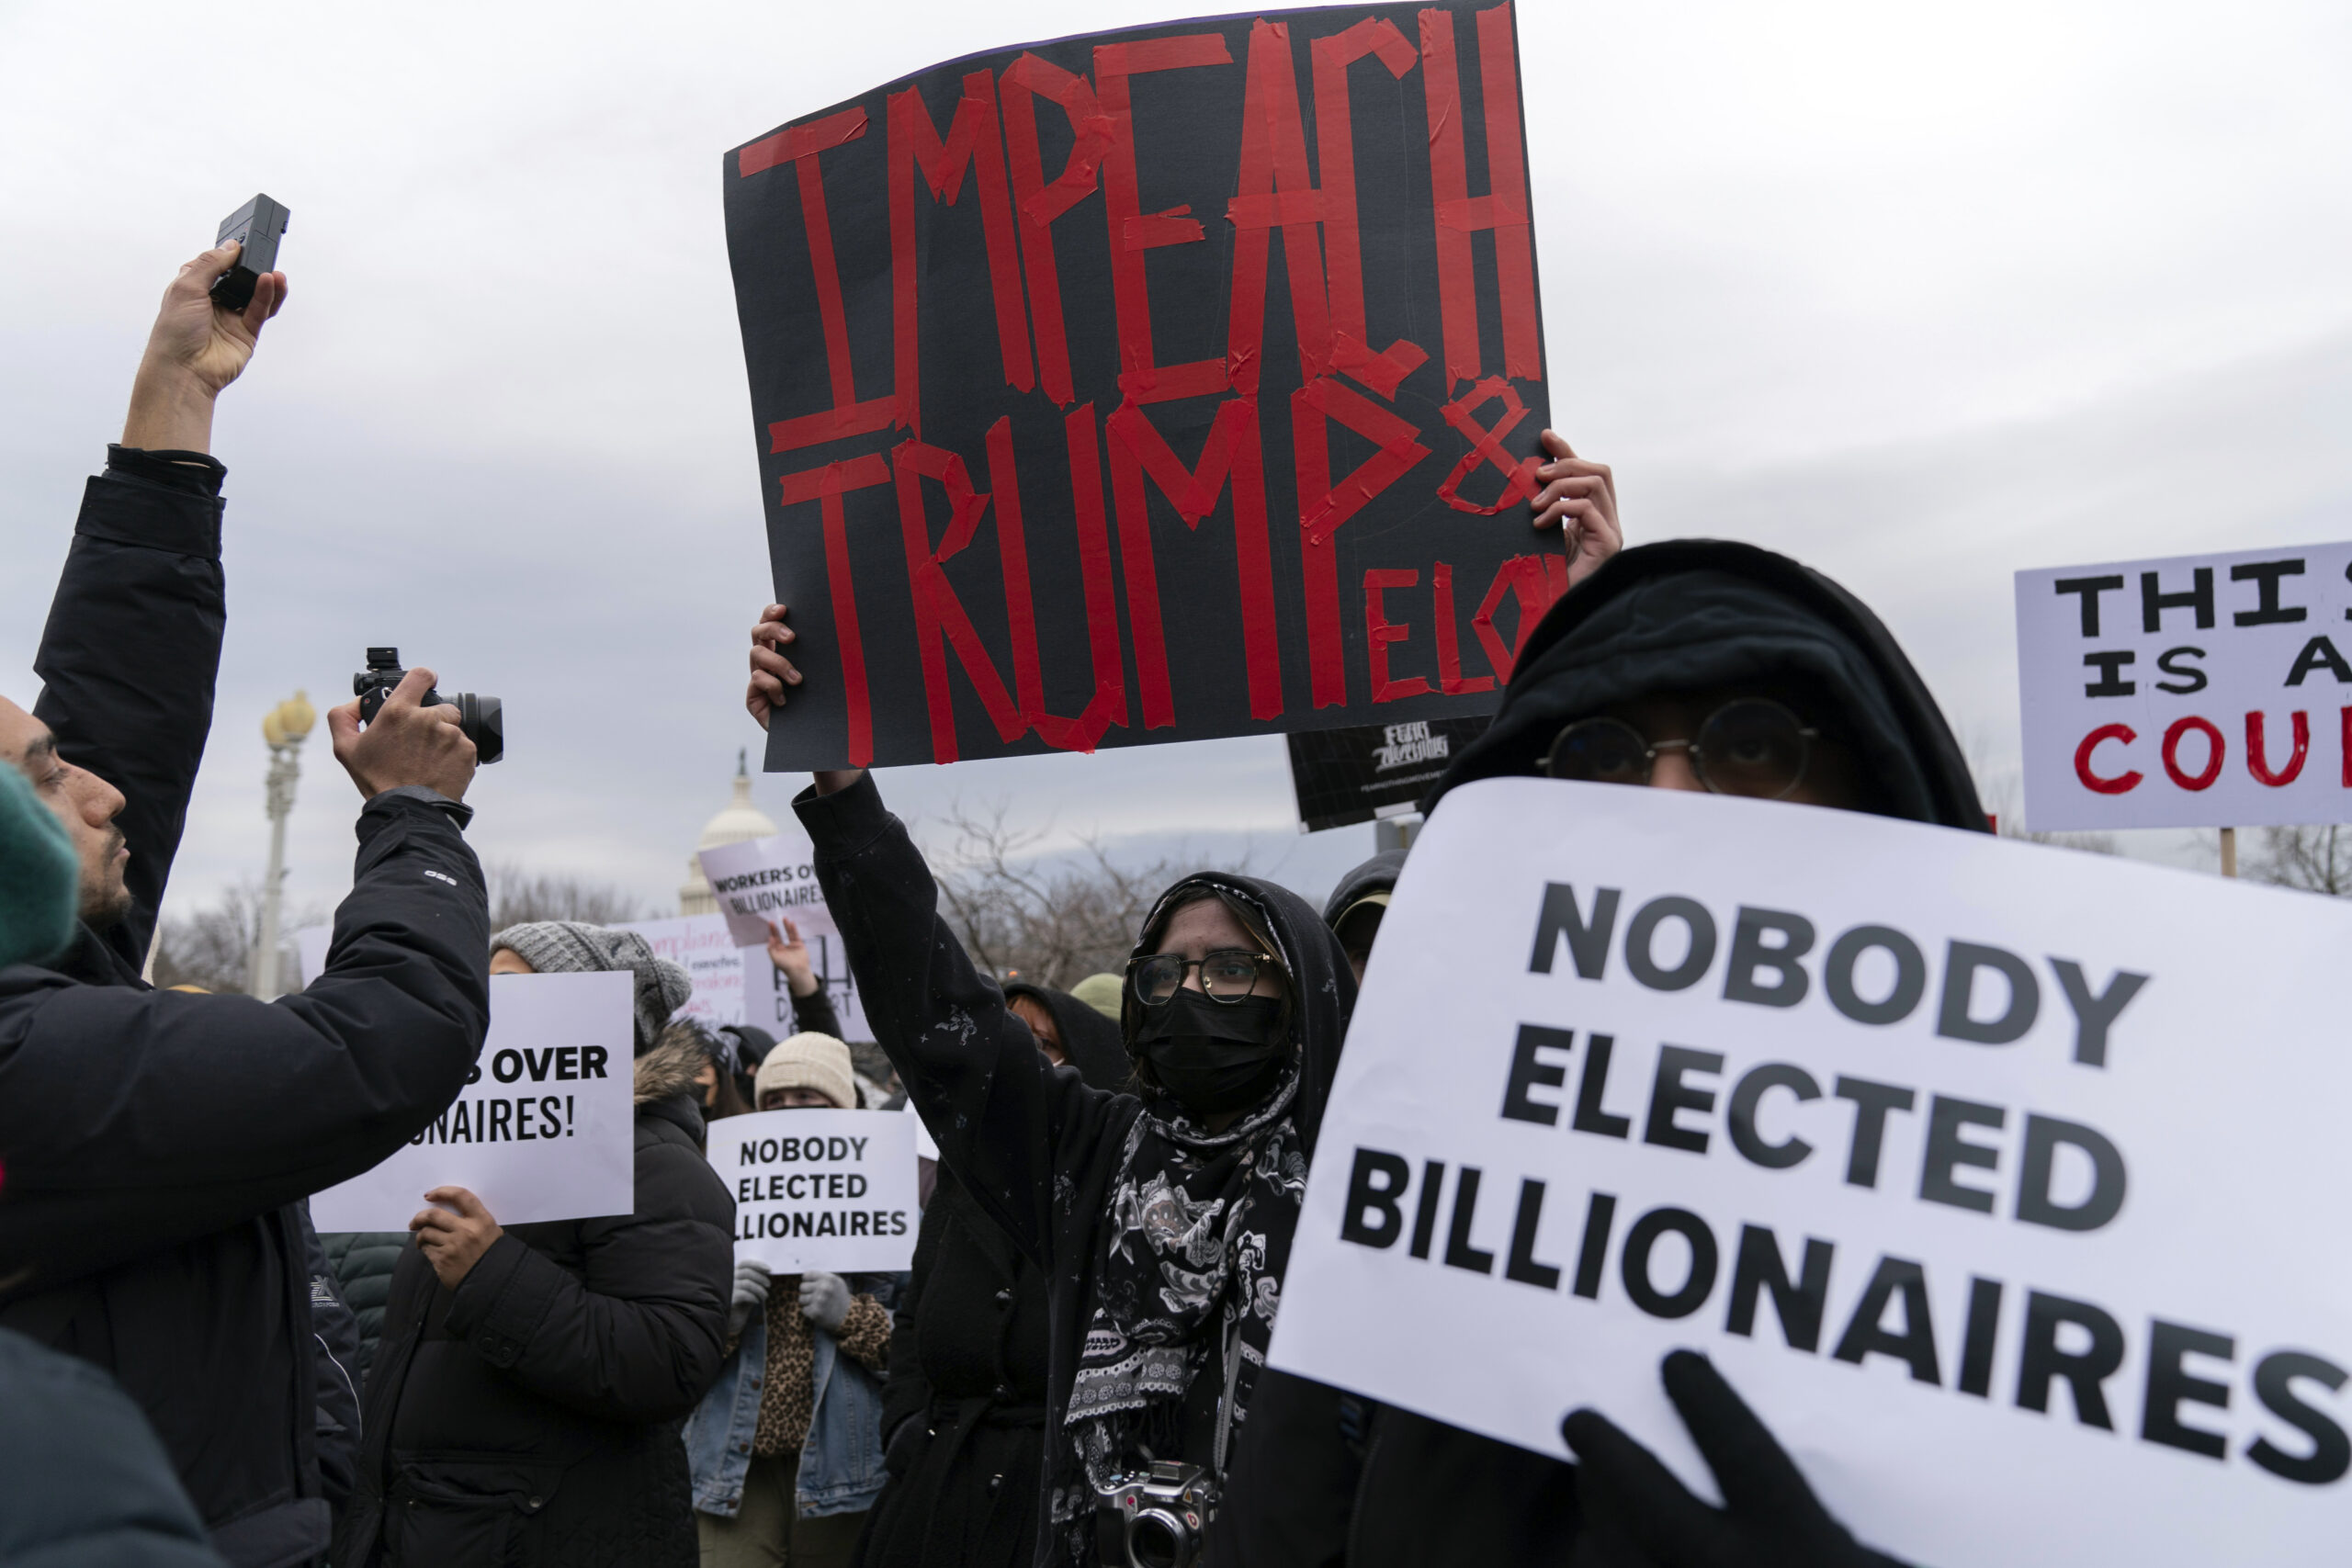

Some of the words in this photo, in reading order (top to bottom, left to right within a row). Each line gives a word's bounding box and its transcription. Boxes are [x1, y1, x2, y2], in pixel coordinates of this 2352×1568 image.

[739, 2, 1542, 454] IMPEACH
[780, 377, 1431, 768] TRUMP
[1437, 376, 1545, 516] &
[2053, 558, 2352, 638] THI
[1363, 553, 1568, 704] ELO
[2083, 646, 2208, 697] IS
[2283, 635, 2352, 687] A
[2074, 705, 2352, 795] COU
[715, 866, 794, 894] WORKERS
[729, 884, 825, 915] BILLIONAIRE
[1527, 882, 2149, 1068] NOBODY
[492, 1045, 608, 1084] OVER
[410, 1095, 575, 1145] NAIRES!
[740, 1136, 868, 1167] NOBODY
[1499, 1022, 2128, 1234] ELECTED
[738, 1174, 867, 1203] ELECTED
[735, 1211, 908, 1241] LIONAIRES
[1339, 1145, 2352, 1487] BILLIONAIRES
